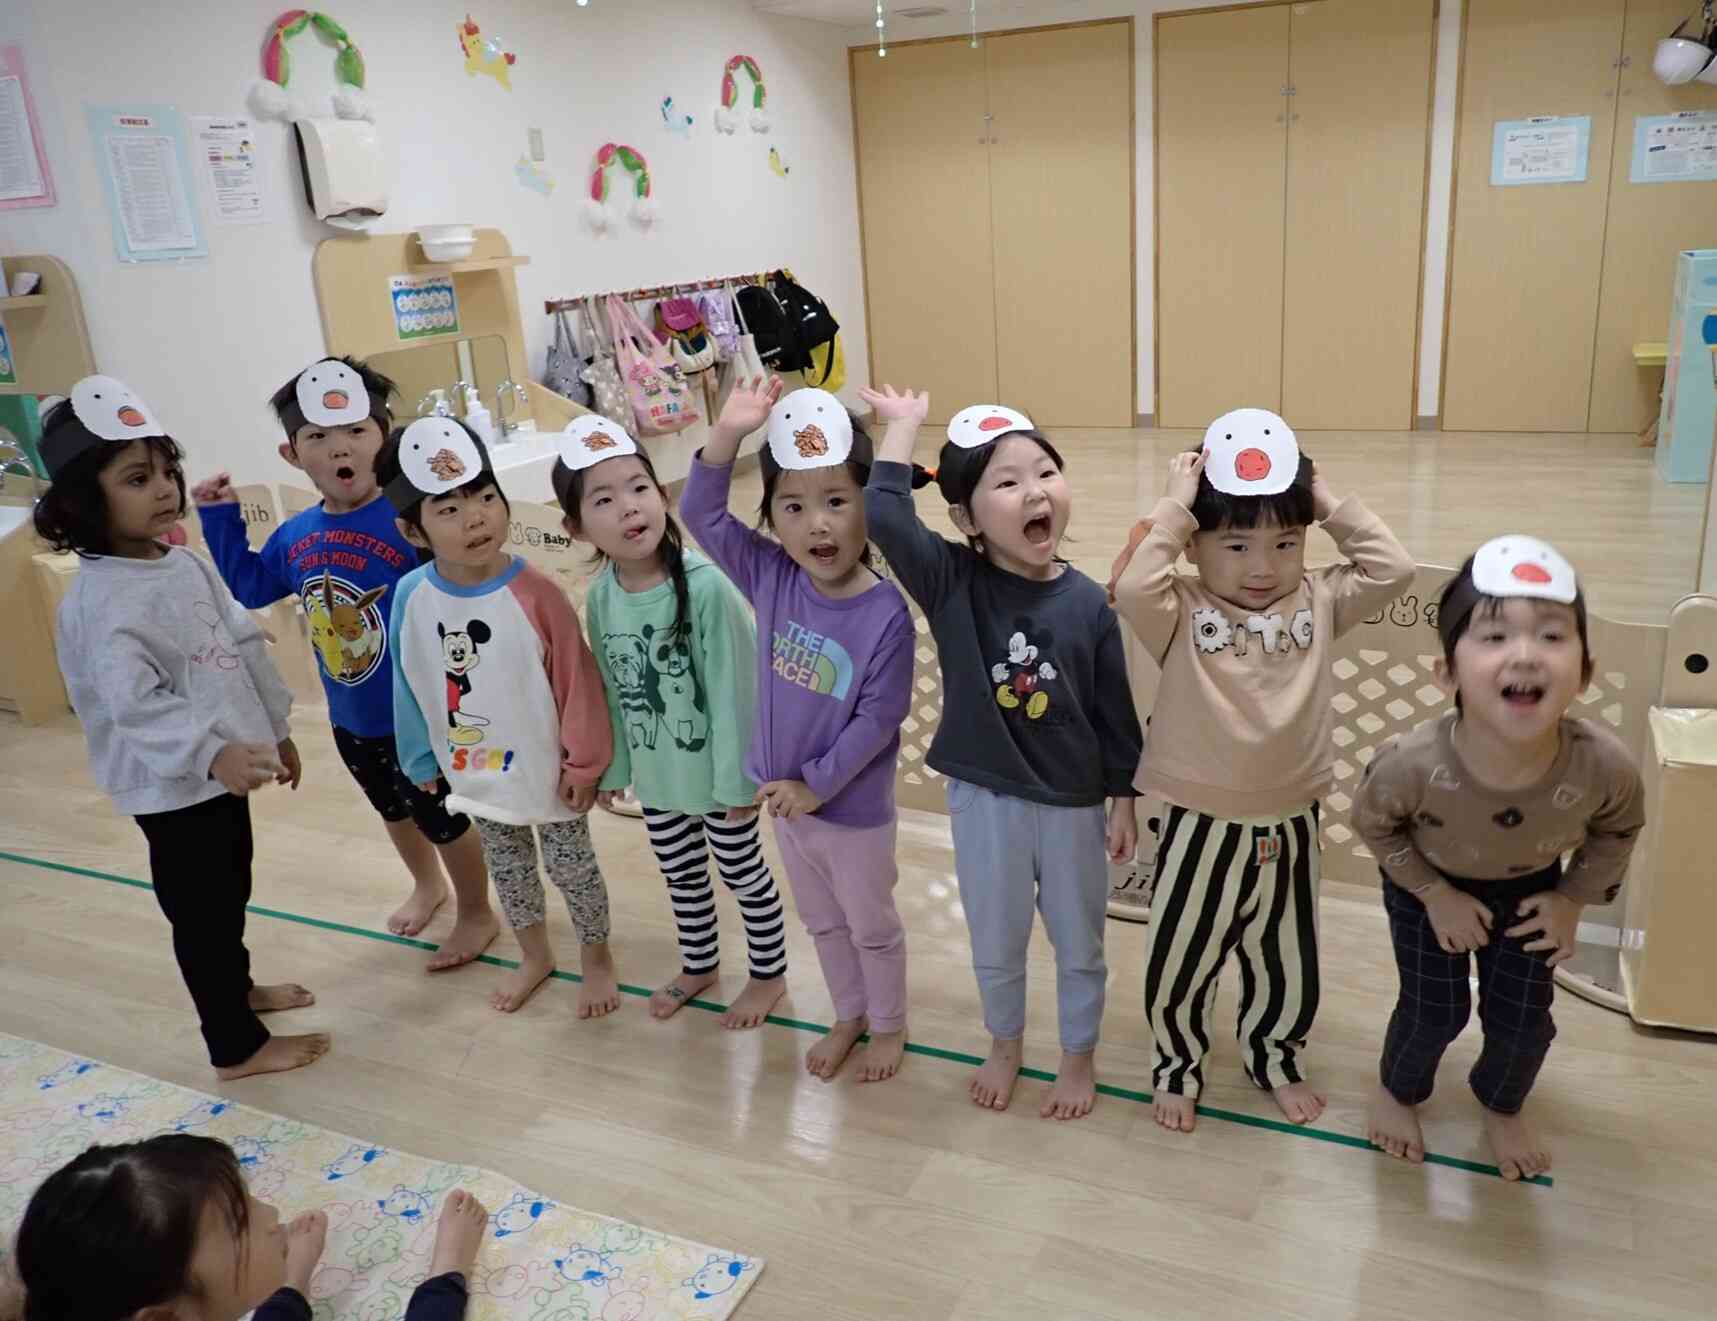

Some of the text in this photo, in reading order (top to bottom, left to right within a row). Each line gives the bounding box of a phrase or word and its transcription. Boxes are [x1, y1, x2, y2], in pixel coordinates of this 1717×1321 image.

[323, 529, 405, 568] MONSTERS
[543, 532, 571, 548] Baby
[331, 551, 368, 571] MOON
[773, 631, 818, 670] ORTH
[787, 620, 825, 652] THE
[772, 656, 812, 688] ACE
[1114, 871, 1153, 891] ji
